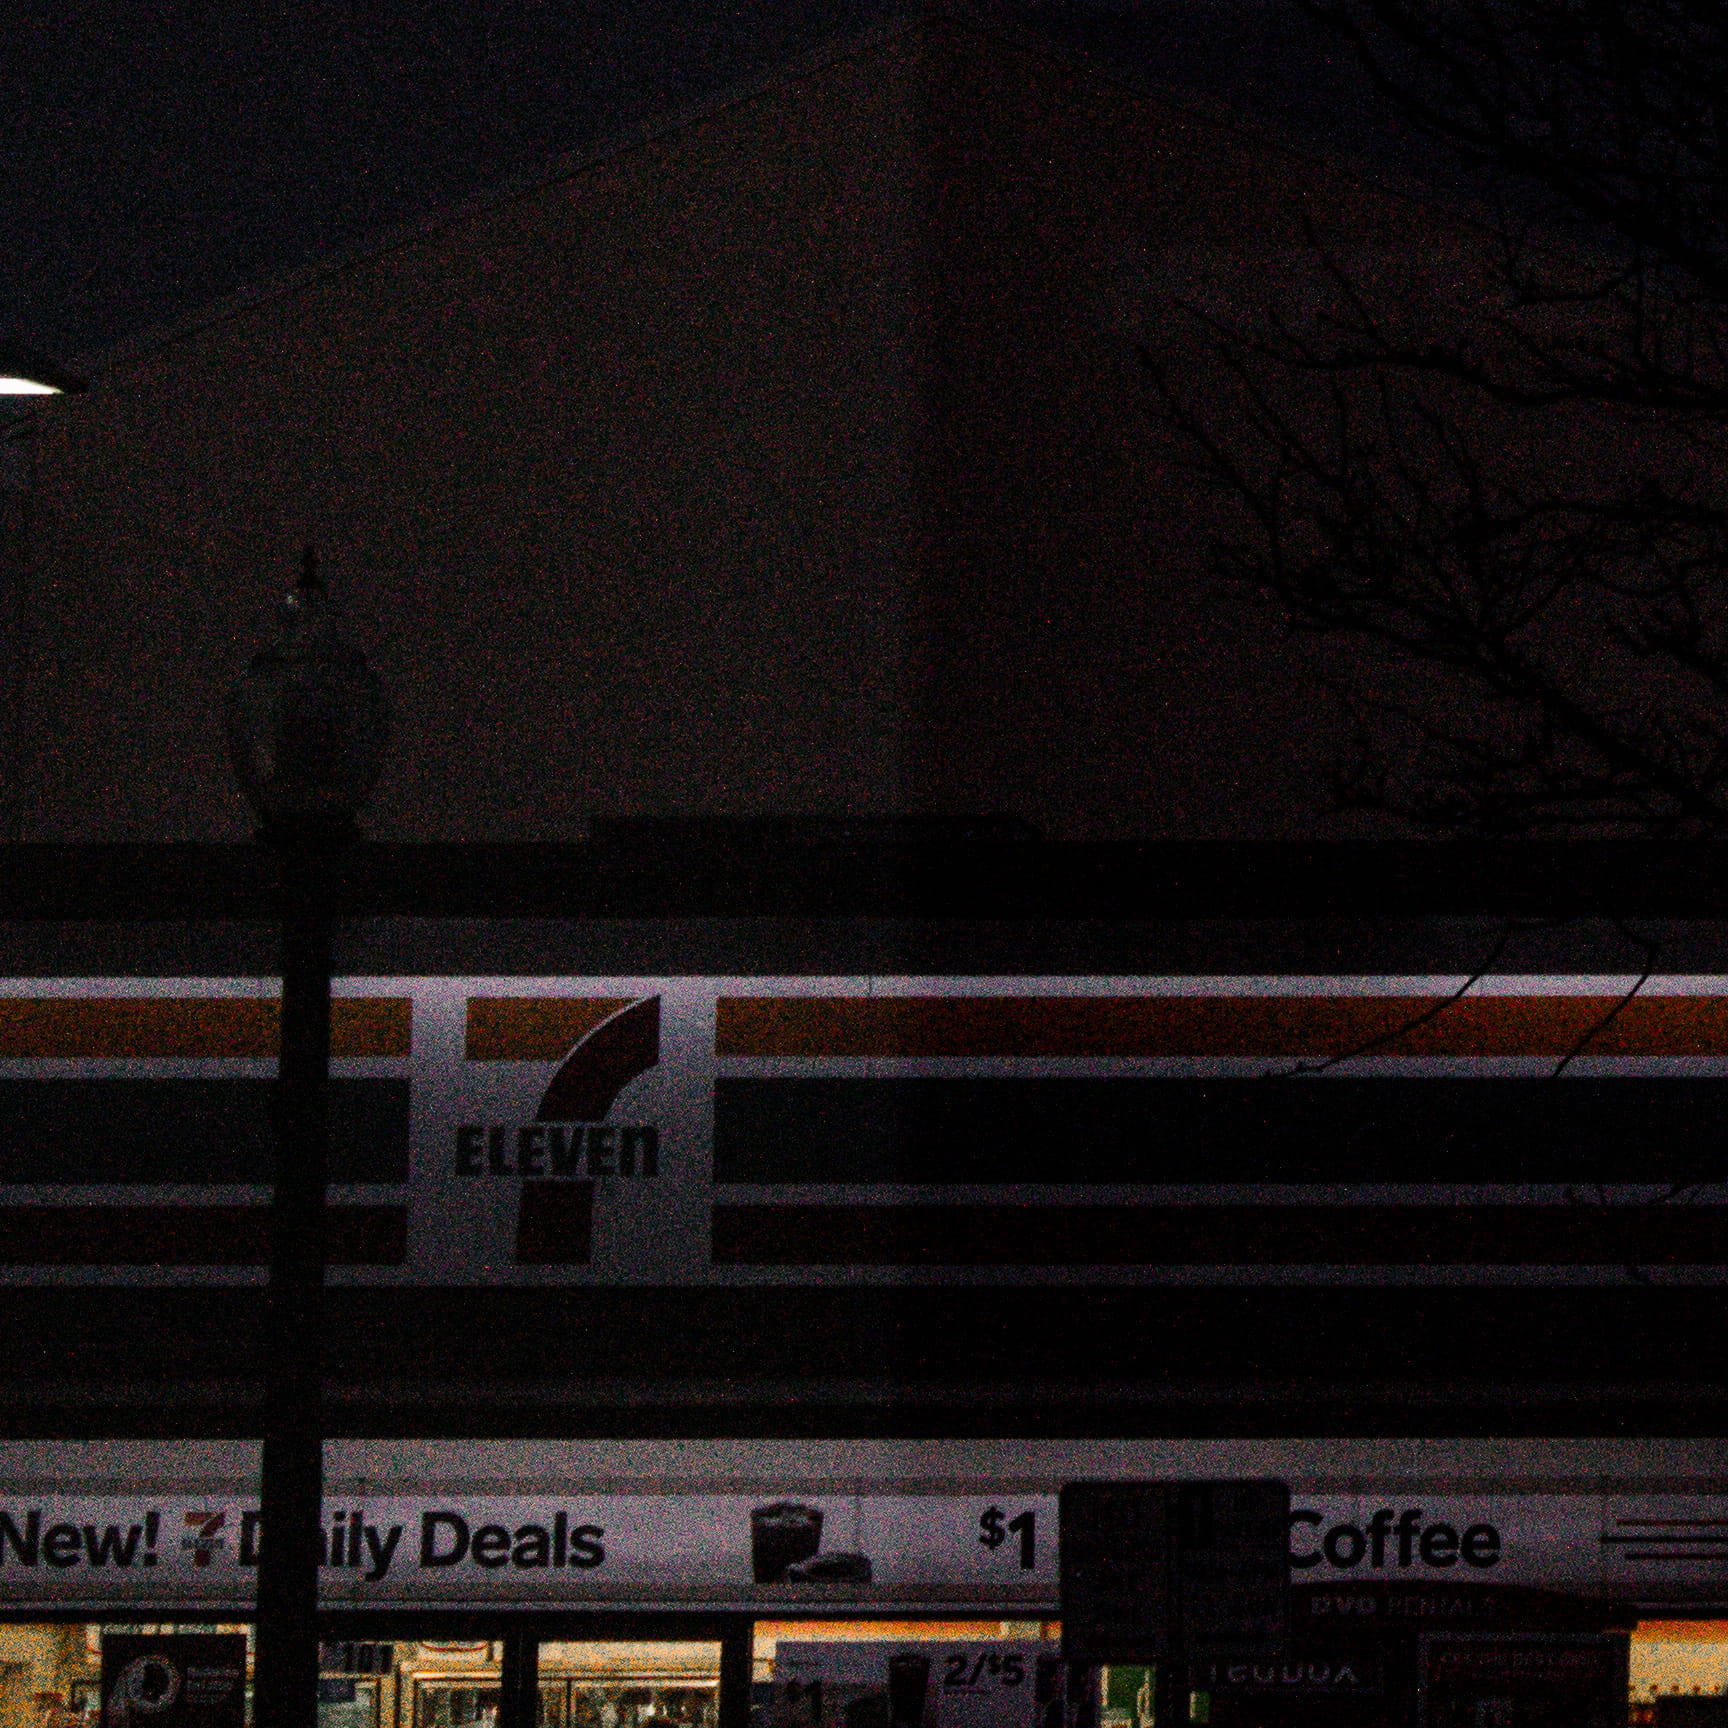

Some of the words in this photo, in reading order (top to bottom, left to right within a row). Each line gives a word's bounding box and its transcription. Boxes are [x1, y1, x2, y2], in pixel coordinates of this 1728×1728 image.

[464, 994, 660, 1264] 7
[0, 1511, 160, 1567] New!
[240, 1511, 402, 1580] Dily
[420, 1511, 606, 1568] Deals
[978, 1507, 1036, 1569] $1
[1288, 1509, 1500, 1568] Coffee
[1309, 1595, 1378, 1616] DVD
[343, 1644, 394, 1673] 101
[943, 1653, 1026, 1686] 2/$5
